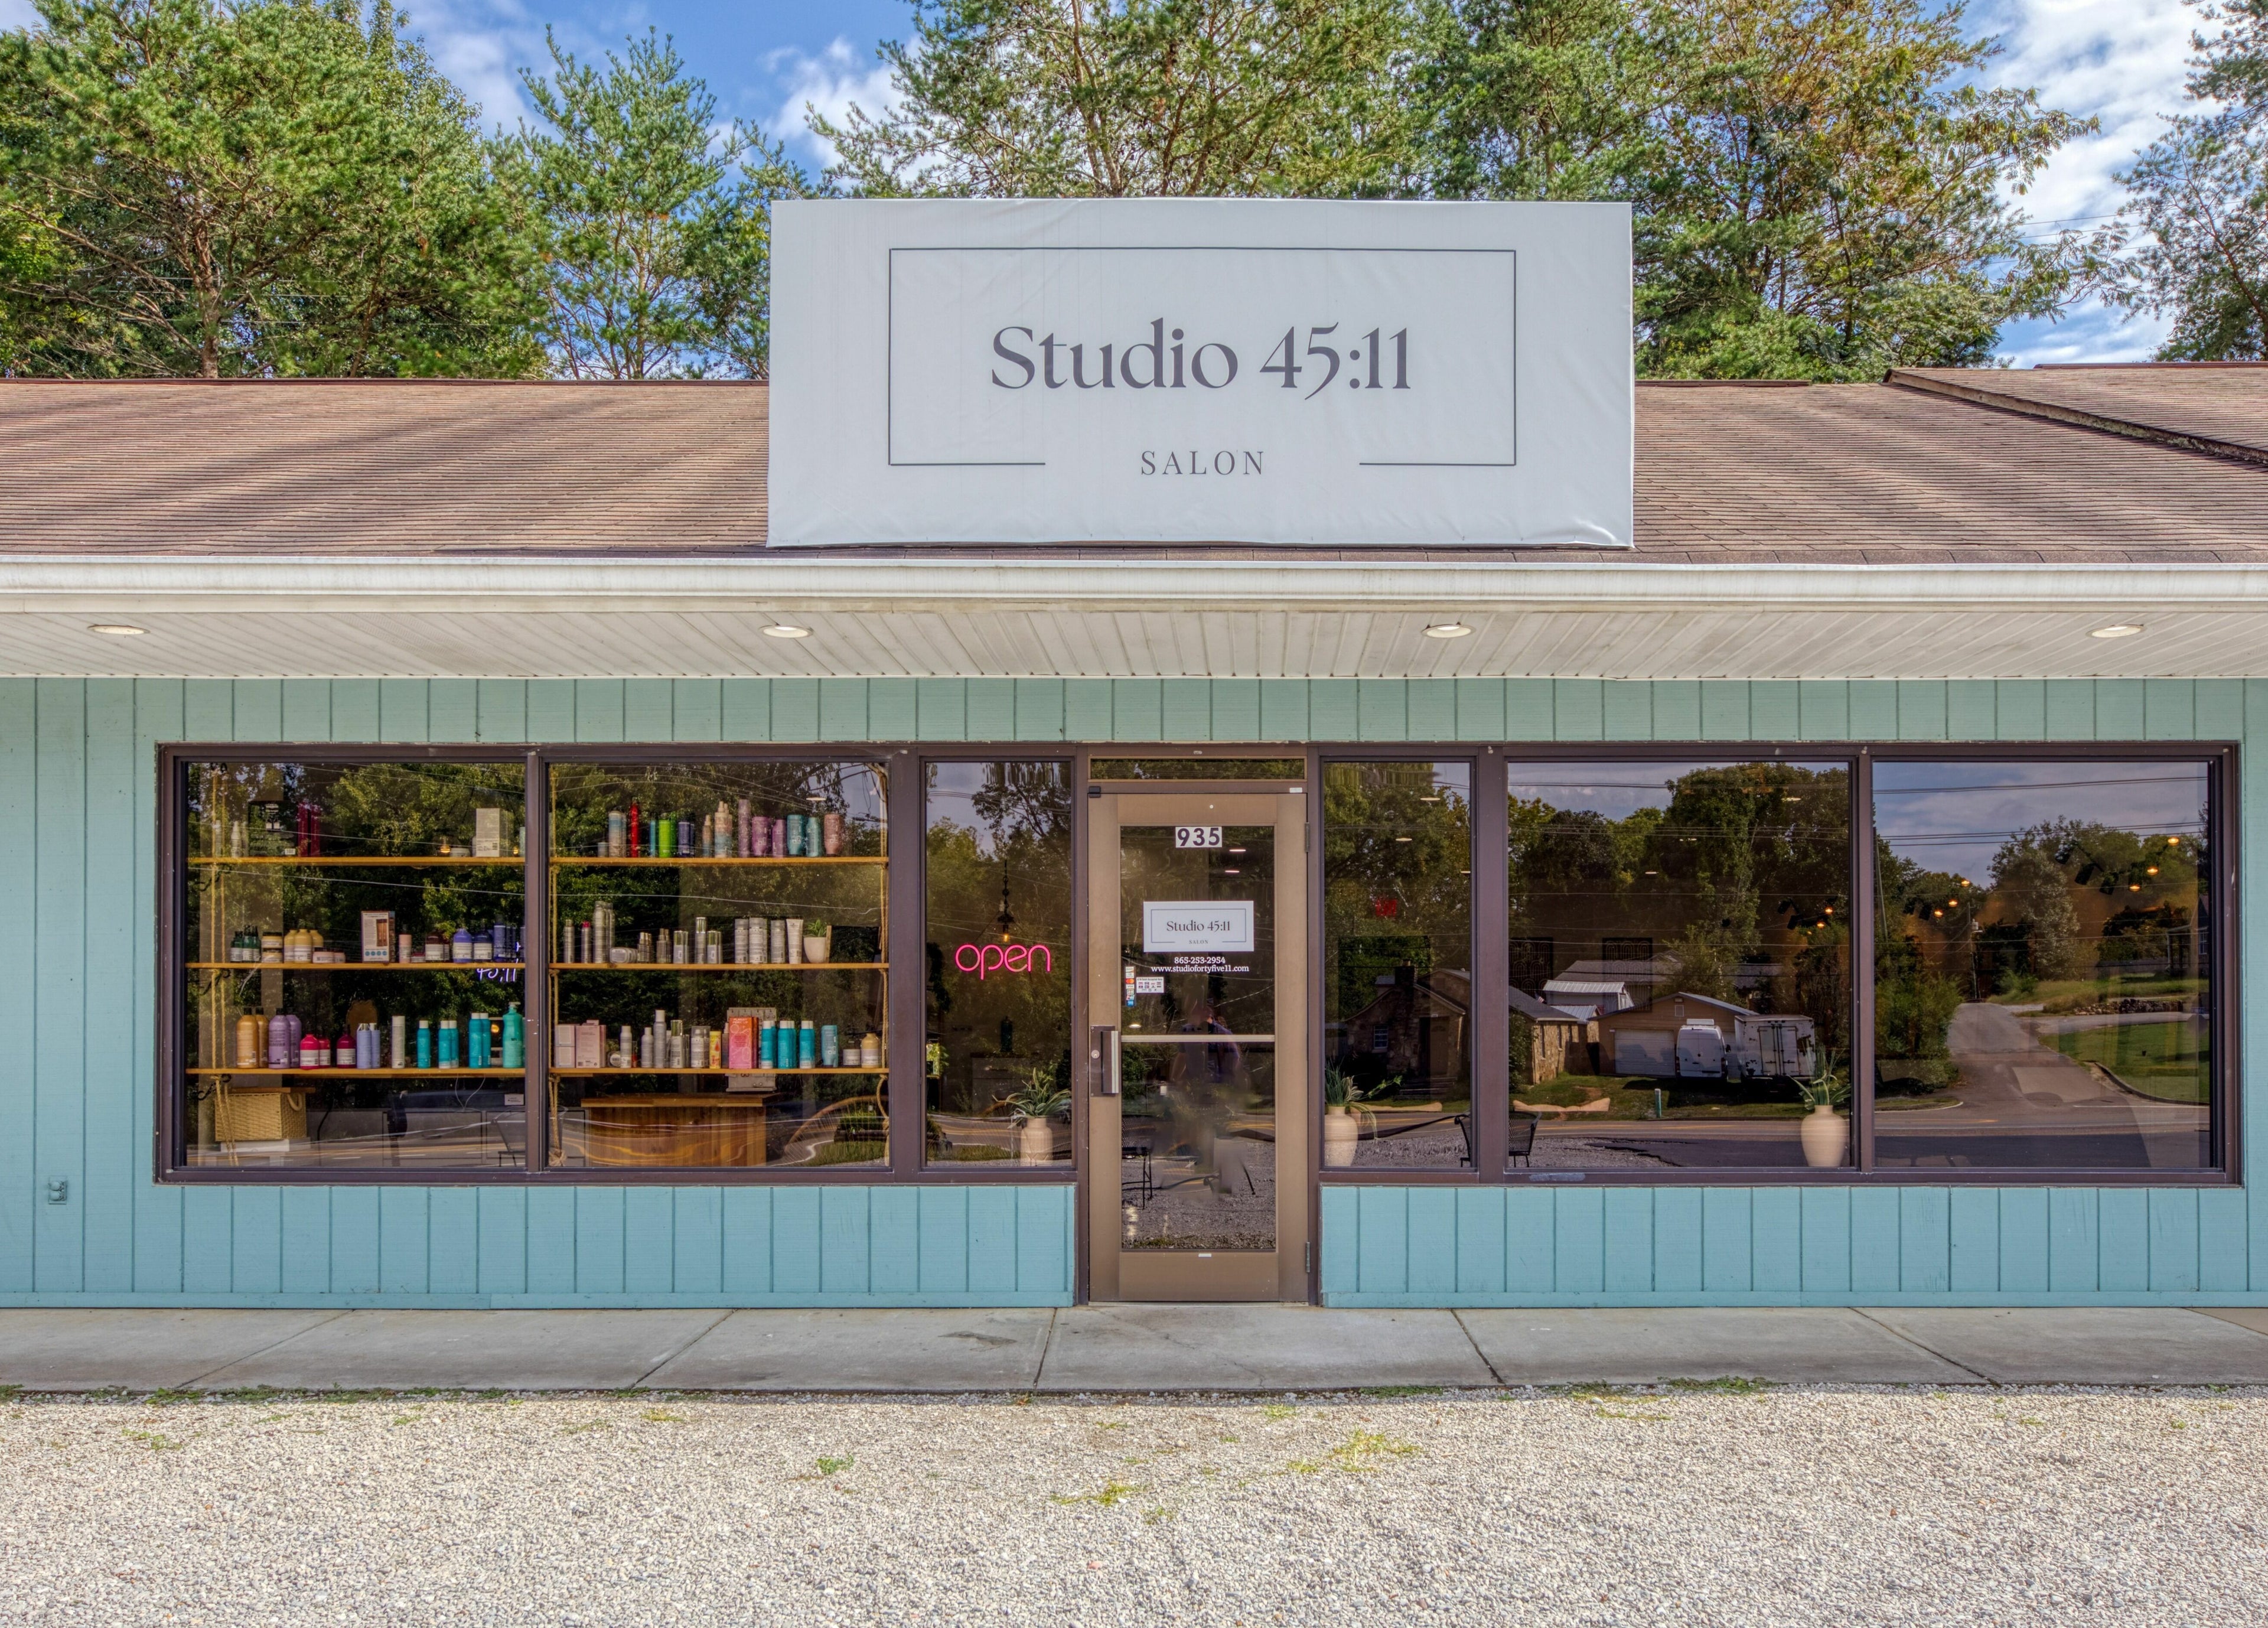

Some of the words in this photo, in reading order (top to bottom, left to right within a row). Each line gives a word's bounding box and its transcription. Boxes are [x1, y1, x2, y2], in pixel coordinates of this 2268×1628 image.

[992, 317, 1239, 389] Studio
[1259, 321, 1412, 401] 45:11
[1140, 451, 1264, 476] SALON
[1177, 827, 1220, 846] 935
[1166, 920, 1205, 932] Studio
[1207, 920, 1231, 933] 45:11
[955, 943, 1051, 981] open
[1151, 965, 1250, 973] www.studiofortyfive11.com
